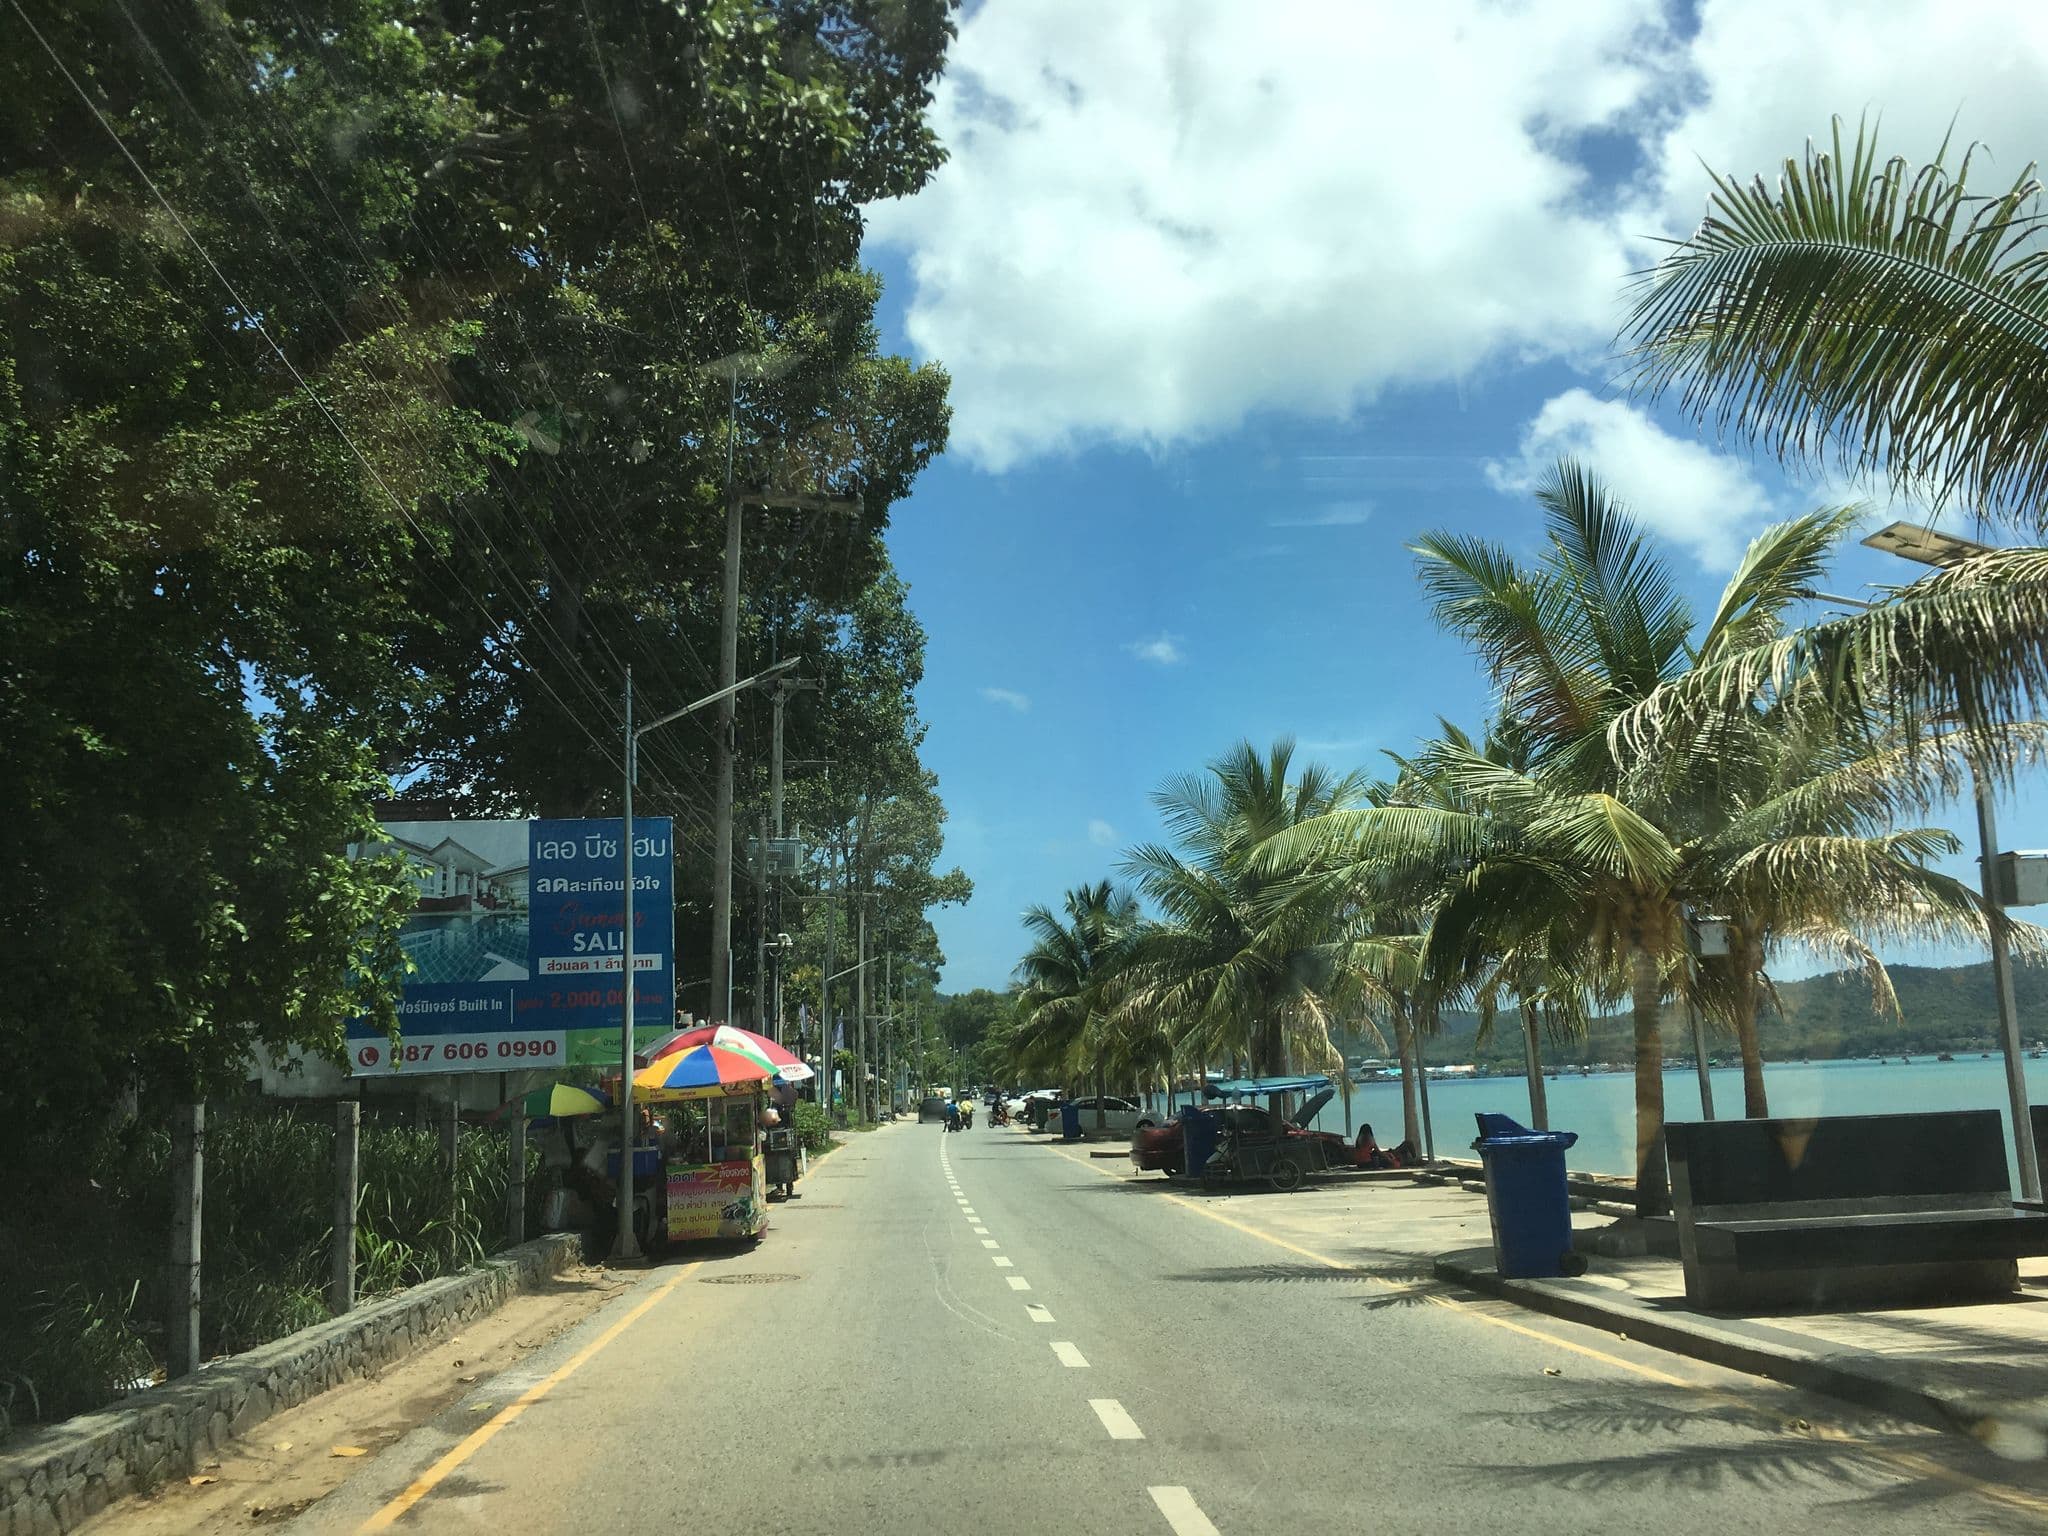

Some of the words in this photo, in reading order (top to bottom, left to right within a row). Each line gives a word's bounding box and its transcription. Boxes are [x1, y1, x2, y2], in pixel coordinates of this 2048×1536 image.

[536, 840, 577, 860] เลอ
[585, 832, 617, 859] บีช
[631, 832, 666, 857] ฮม
[593, 959, 600, 970] 1
[459, 999, 489, 1012] Built
[491, 998, 503, 1011] In
[443, 1043, 489, 1060] 606
[497, 1040, 557, 1058] 0990
